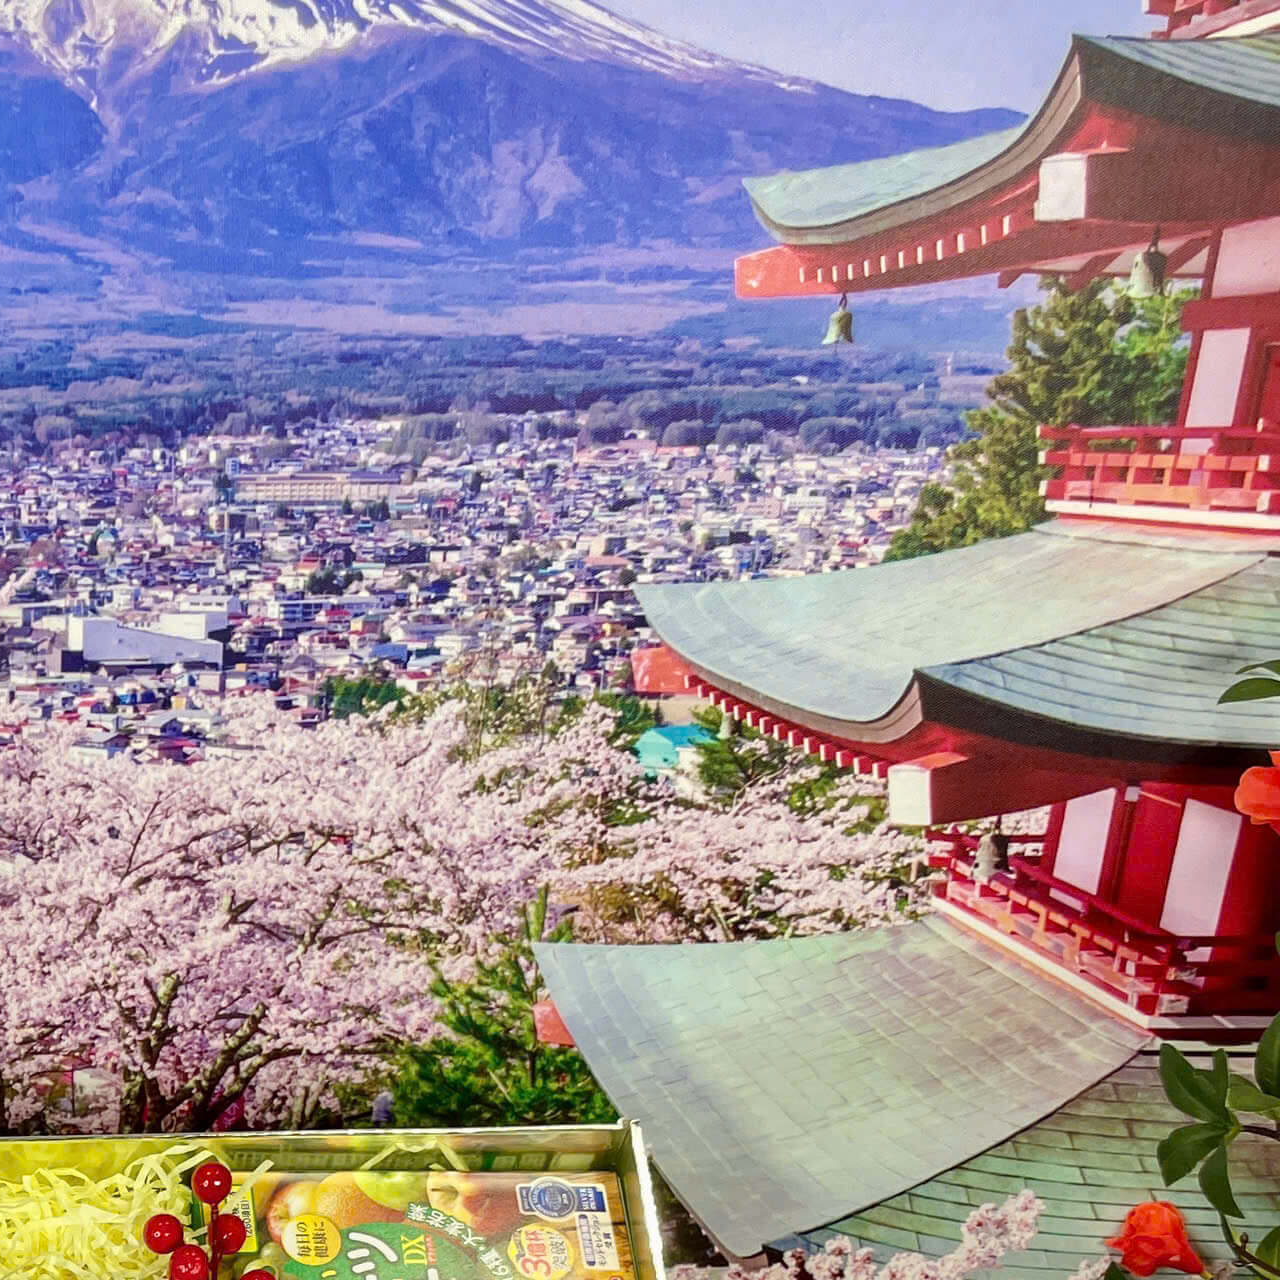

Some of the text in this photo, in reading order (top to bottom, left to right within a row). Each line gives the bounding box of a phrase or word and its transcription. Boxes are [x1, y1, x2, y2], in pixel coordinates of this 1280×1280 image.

[296, 1222, 311, 1257] 毎日の
[401, 1235, 428, 1265] DX
